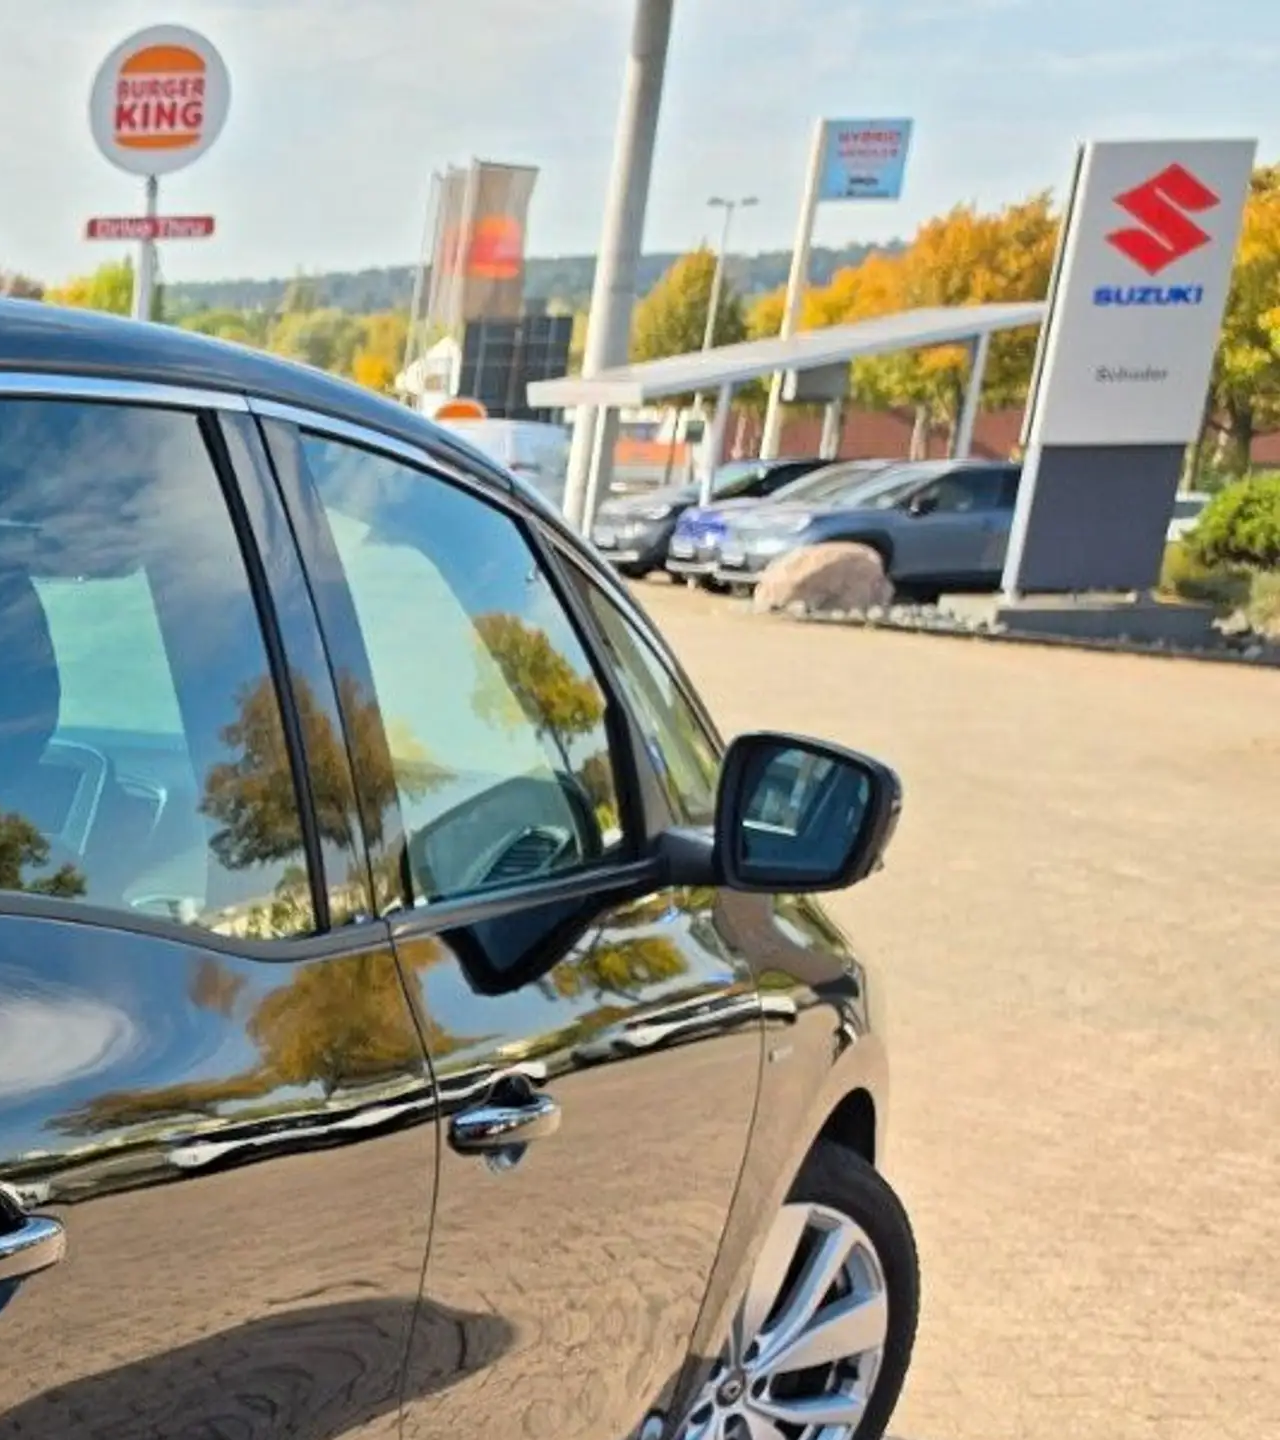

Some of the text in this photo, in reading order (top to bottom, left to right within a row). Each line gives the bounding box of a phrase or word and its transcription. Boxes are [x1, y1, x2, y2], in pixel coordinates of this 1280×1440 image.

[116, 77, 205, 98] BURGER
[115, 101, 203, 131] KING
[1093, 284, 1203, 306] SUZUKI
